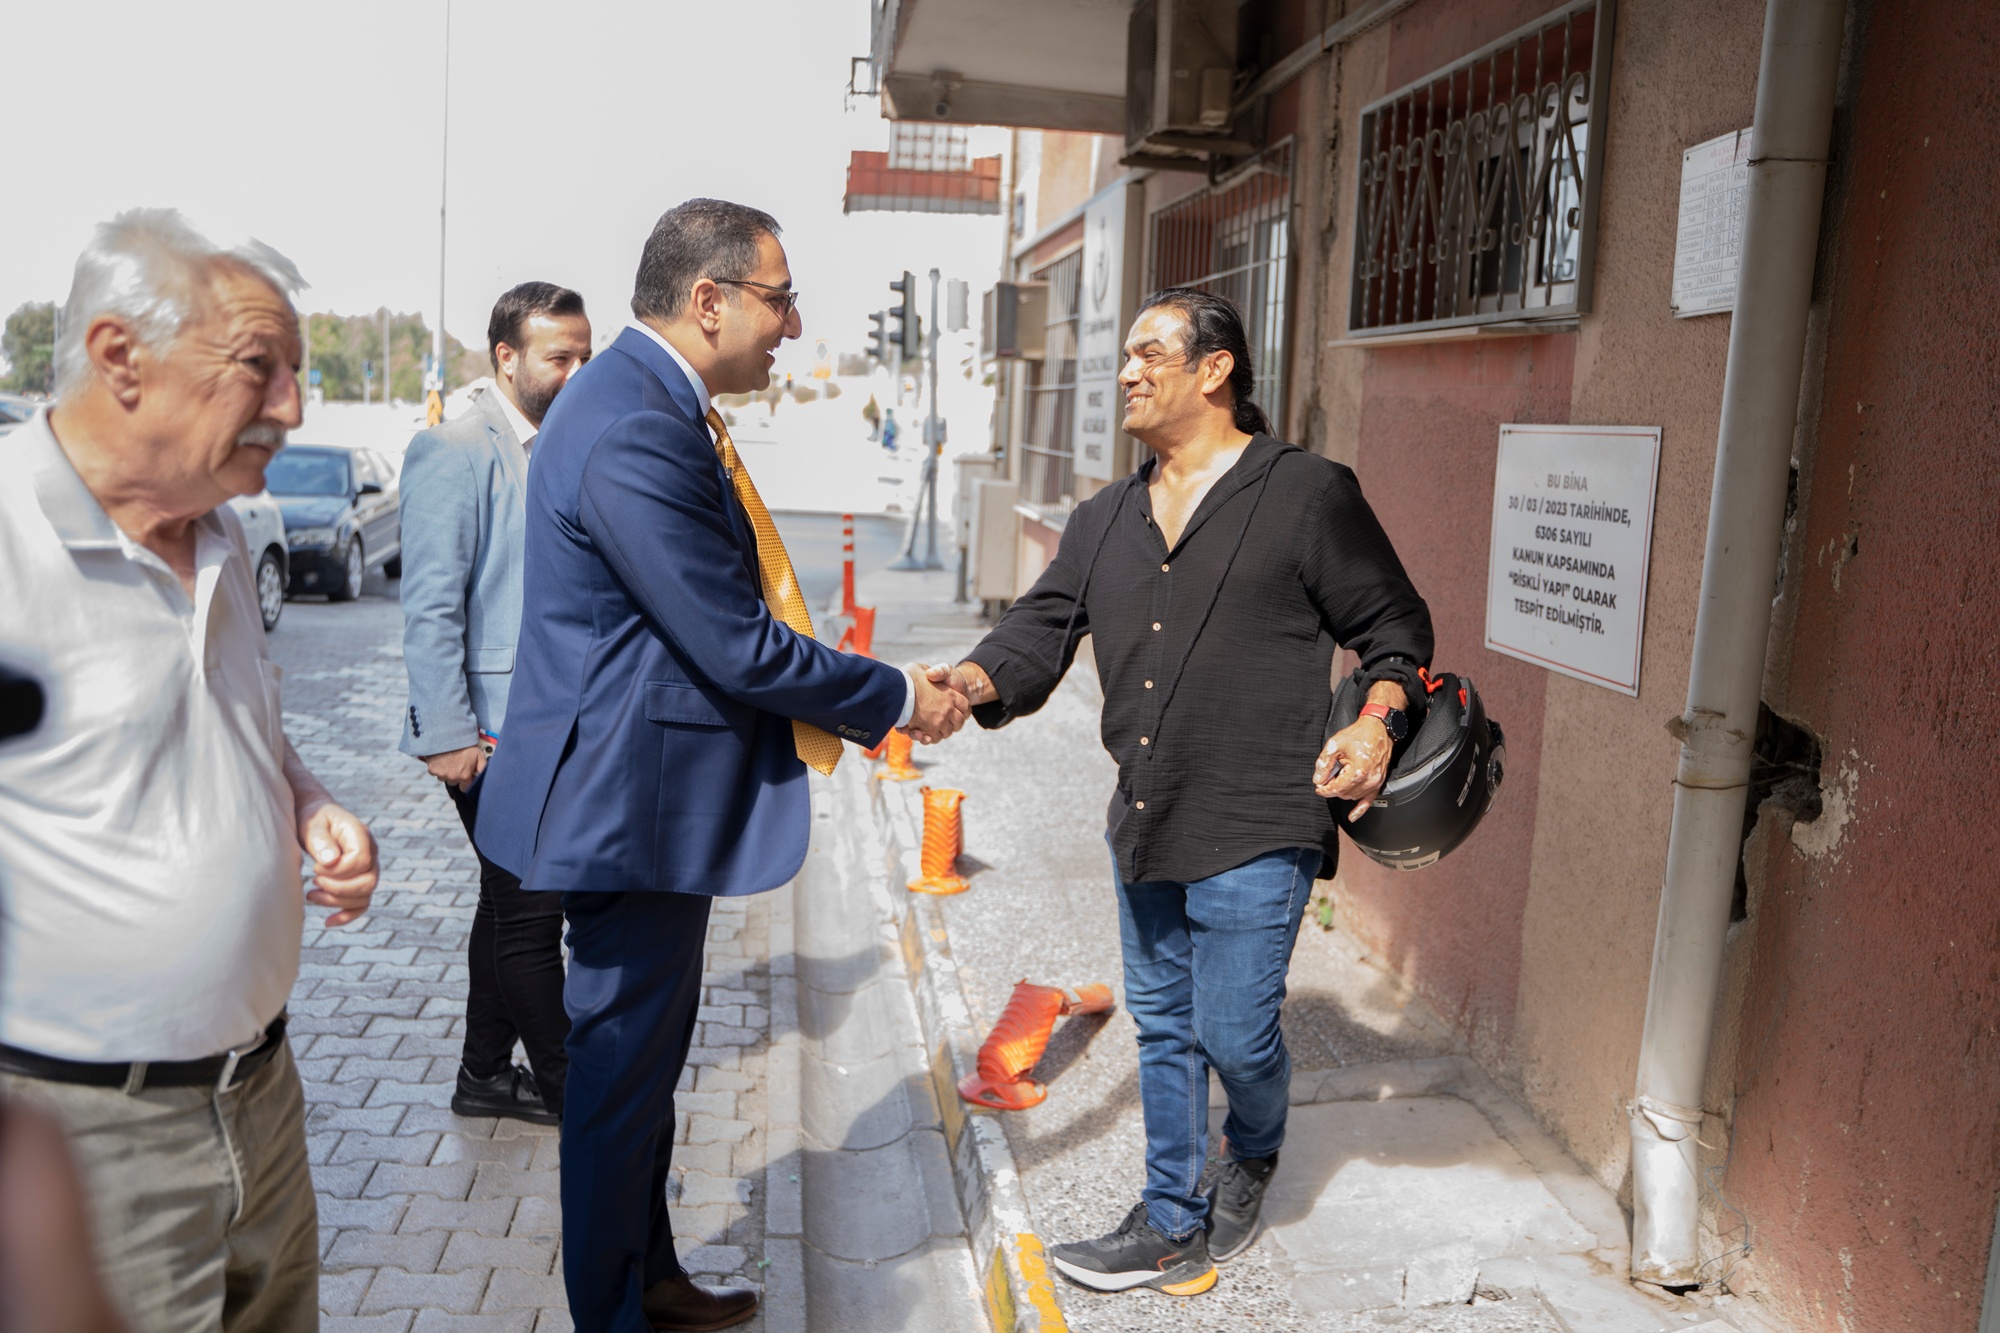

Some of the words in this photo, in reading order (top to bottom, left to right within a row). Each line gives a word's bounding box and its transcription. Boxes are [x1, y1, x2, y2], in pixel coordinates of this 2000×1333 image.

[1701, 262, 1720, 273] KAPALI
[1700, 274, 1719, 286] KAPALI
[1547, 473, 1560, 489] BU
[1563, 471, 1588, 492] BİNA
[1508, 495, 1519, 510] 30
[1527, 498, 1537, 512] 03
[1545, 499, 1567, 517] 2023
[1570, 499, 1631, 527] TARİHİNDE,
[1535, 525, 1557, 543] 6306
[1559, 527, 1592, 548] SAYILI
[1512, 546, 1544, 566] KANUN
[1546, 552, 1615, 581] KAPSAMINDA
[1573, 585, 1617, 610] OLARAK
[1514, 597, 1544, 618] TESPİT
[1546, 606, 1604, 635] EDİLMİŞTİR.
